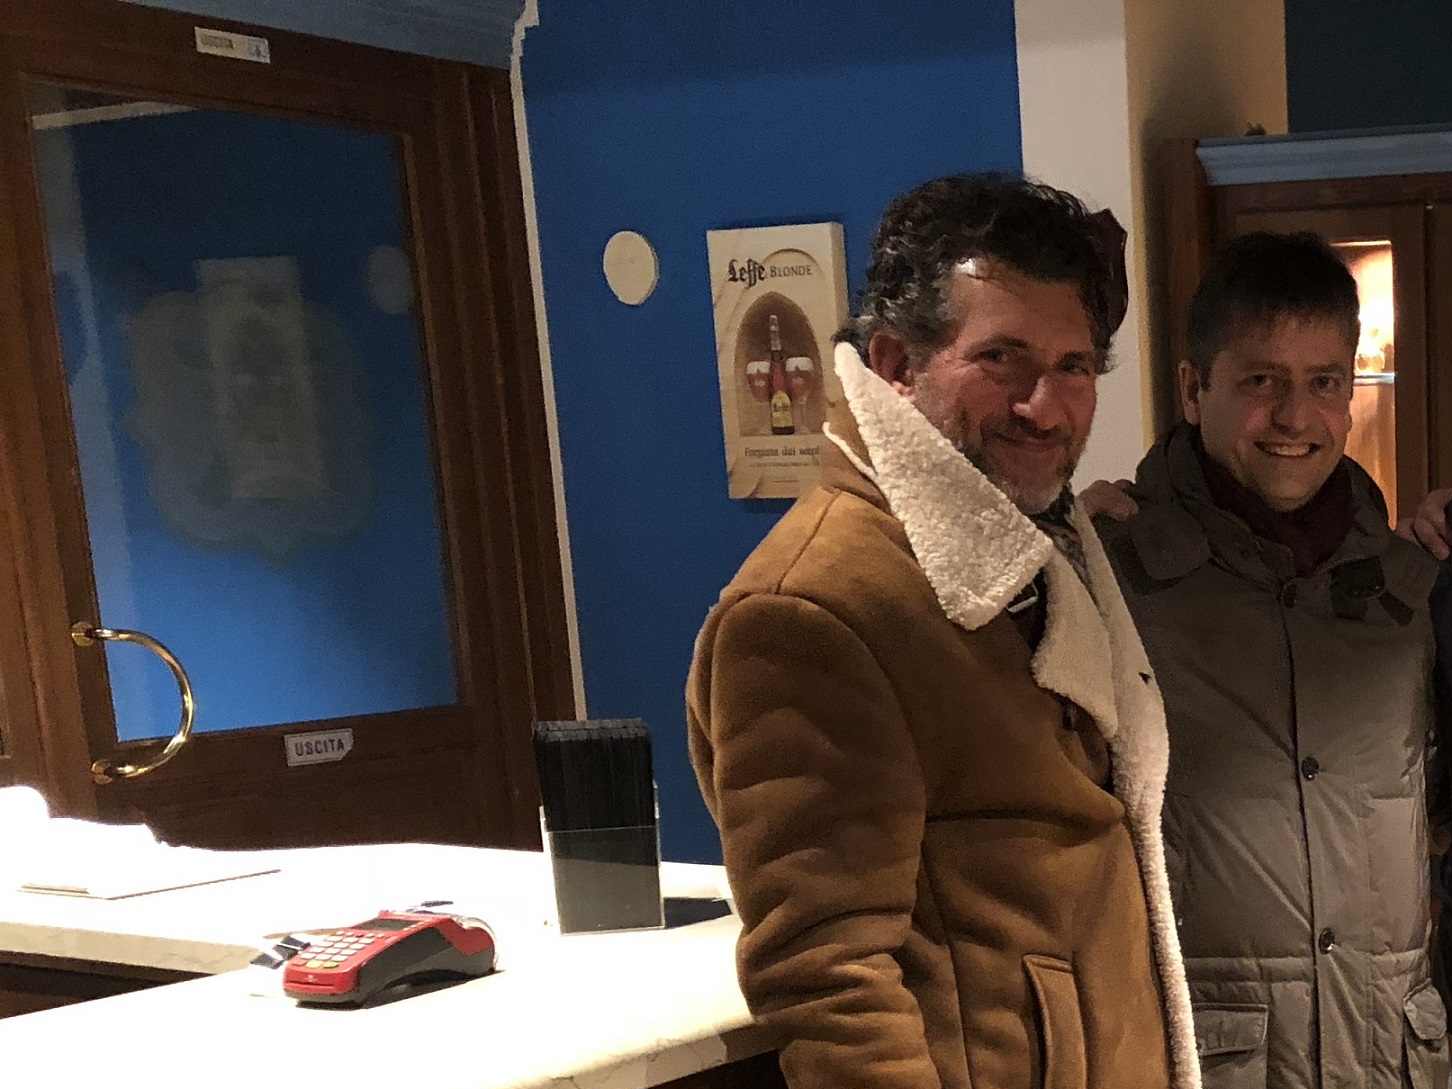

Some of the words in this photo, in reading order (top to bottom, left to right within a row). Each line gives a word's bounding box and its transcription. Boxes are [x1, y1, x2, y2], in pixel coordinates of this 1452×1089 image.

[728, 257, 766, 289] Leffe
[769, 264, 813, 278] BLONDE
[295, 739, 345, 756] USCITA
